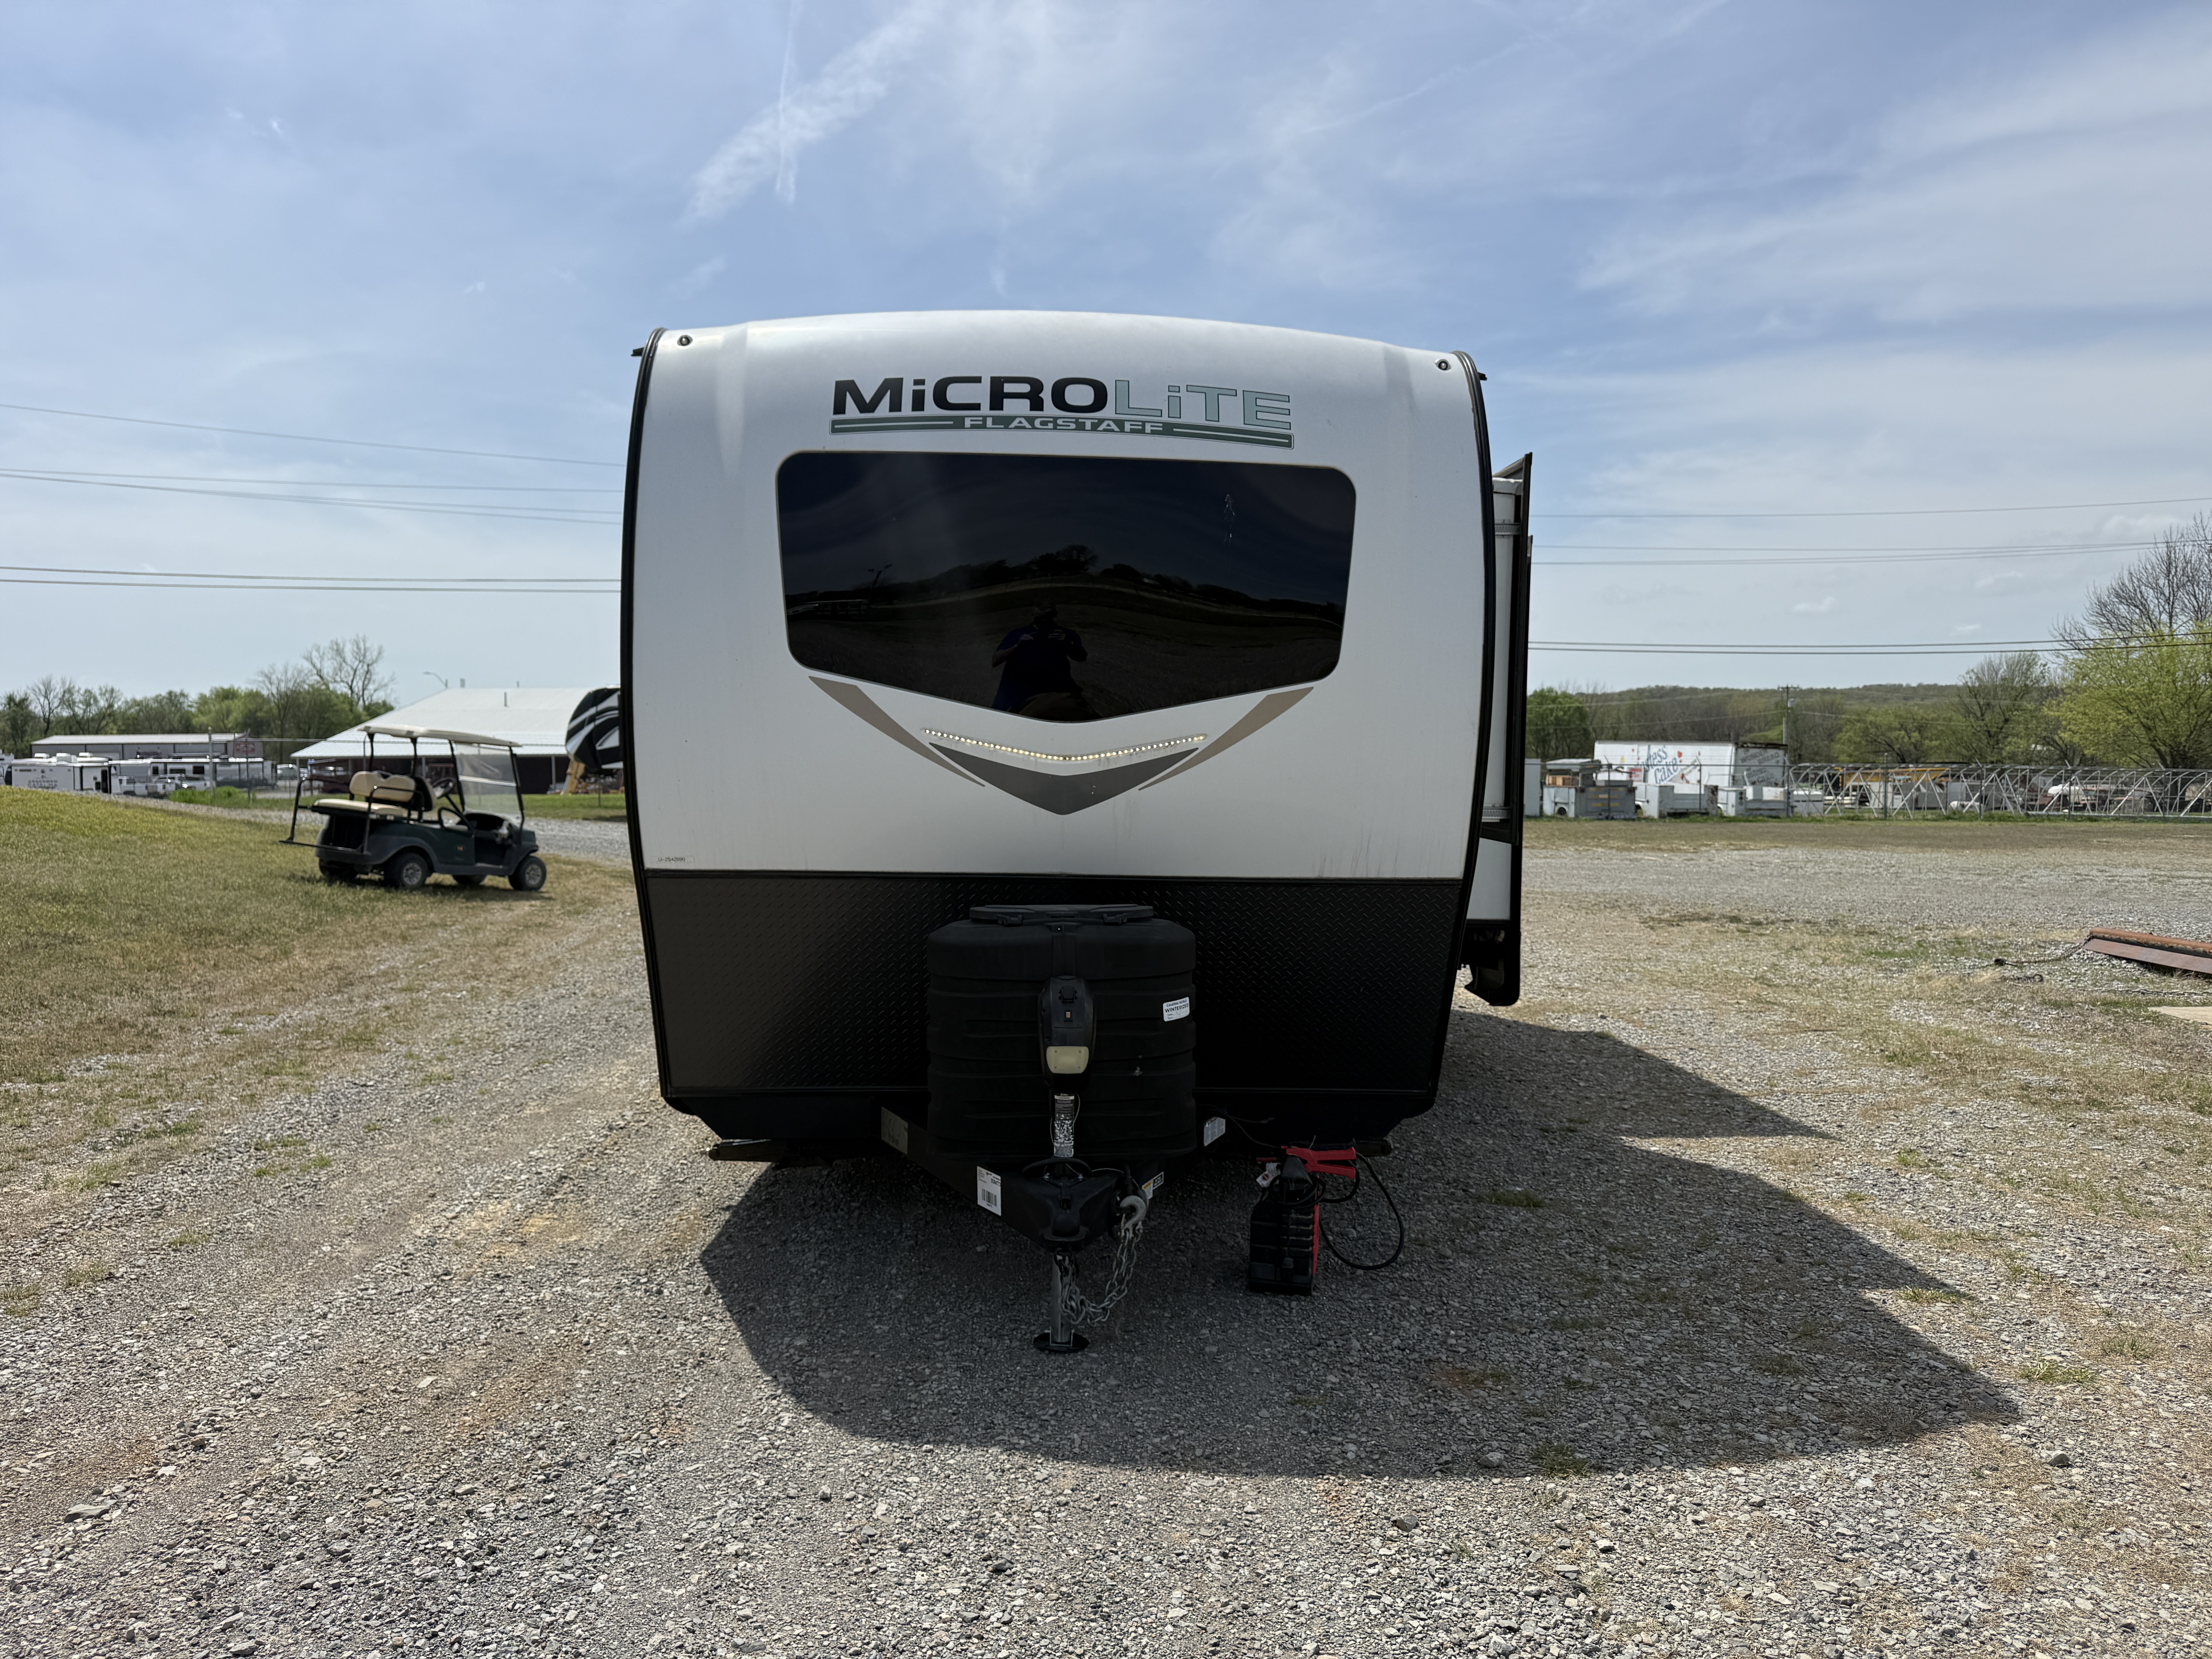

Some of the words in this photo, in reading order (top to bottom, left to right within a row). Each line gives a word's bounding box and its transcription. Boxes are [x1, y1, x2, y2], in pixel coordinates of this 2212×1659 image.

[964, 416, 1163, 433] FLAGSTAFF
[1654, 757, 1678, 784] Cake
[1165, 1003, 1188, 1013] WINTERIZED
